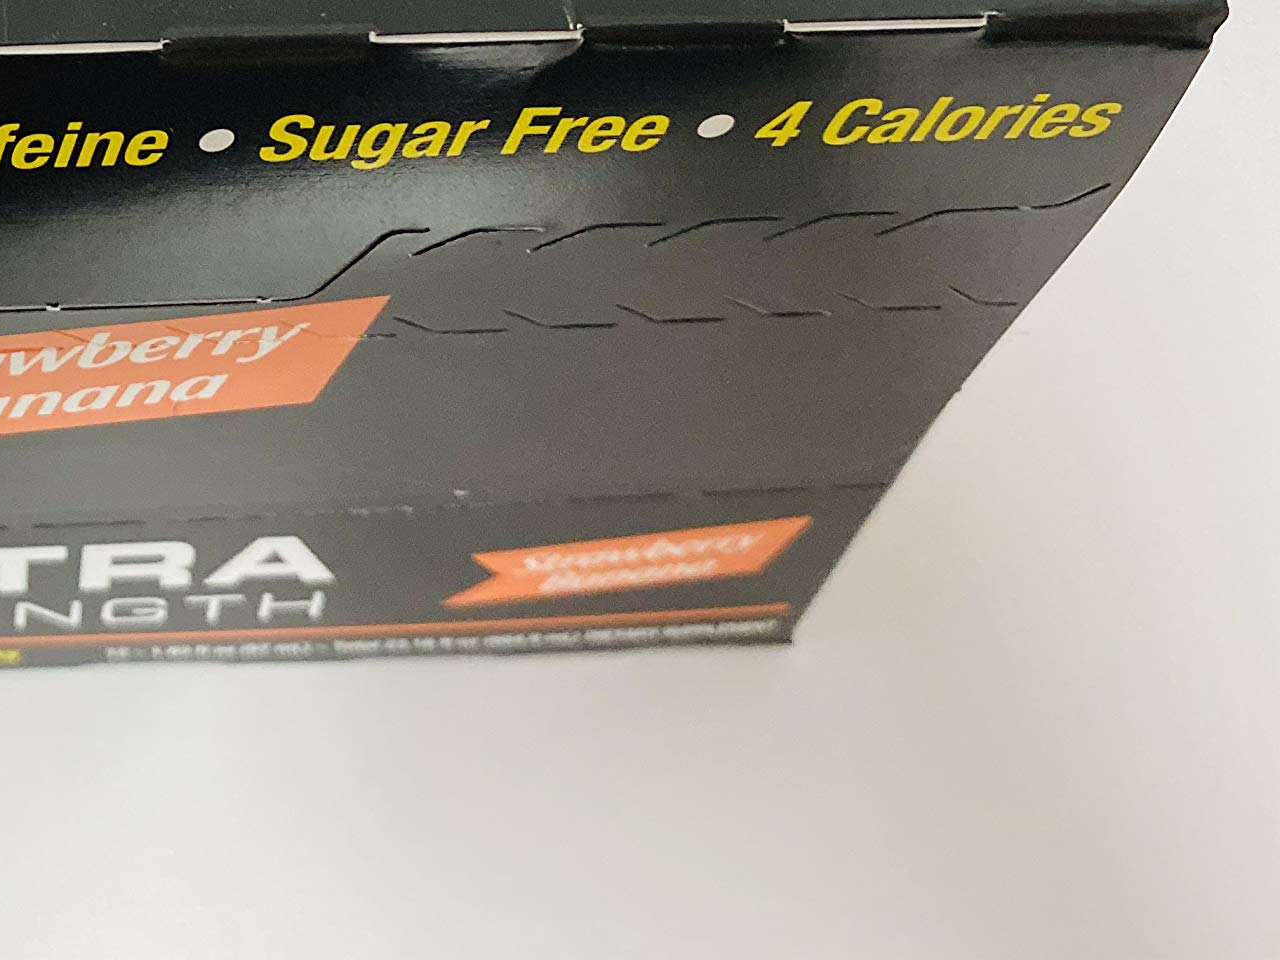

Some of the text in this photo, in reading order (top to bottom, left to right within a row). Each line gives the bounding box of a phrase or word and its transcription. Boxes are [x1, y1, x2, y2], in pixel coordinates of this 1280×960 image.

[259, 113, 489, 170] Sugar
[498, 105, 670, 156] Free
[755, 101, 812, 148] 4
[822, 91, 1123, 146] Calories
